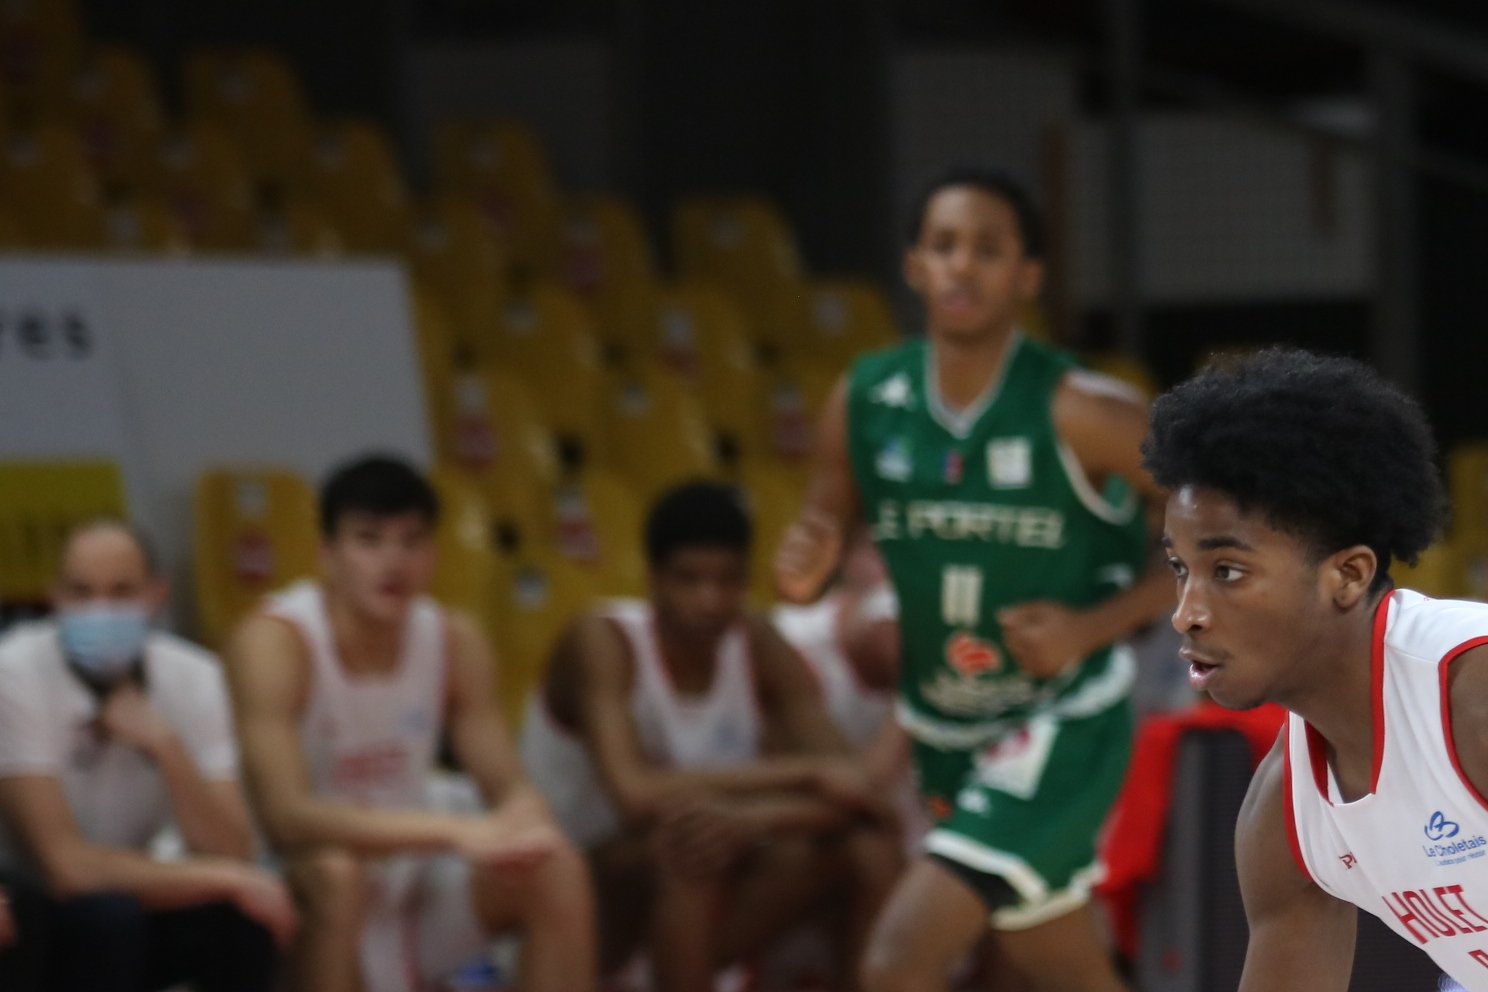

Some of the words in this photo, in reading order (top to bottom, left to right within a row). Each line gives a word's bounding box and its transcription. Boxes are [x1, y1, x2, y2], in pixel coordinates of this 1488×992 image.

[0, 308, 93, 359] es
[1422, 845, 1436, 857] Le
[1434, 836, 1487, 857] Choletais
